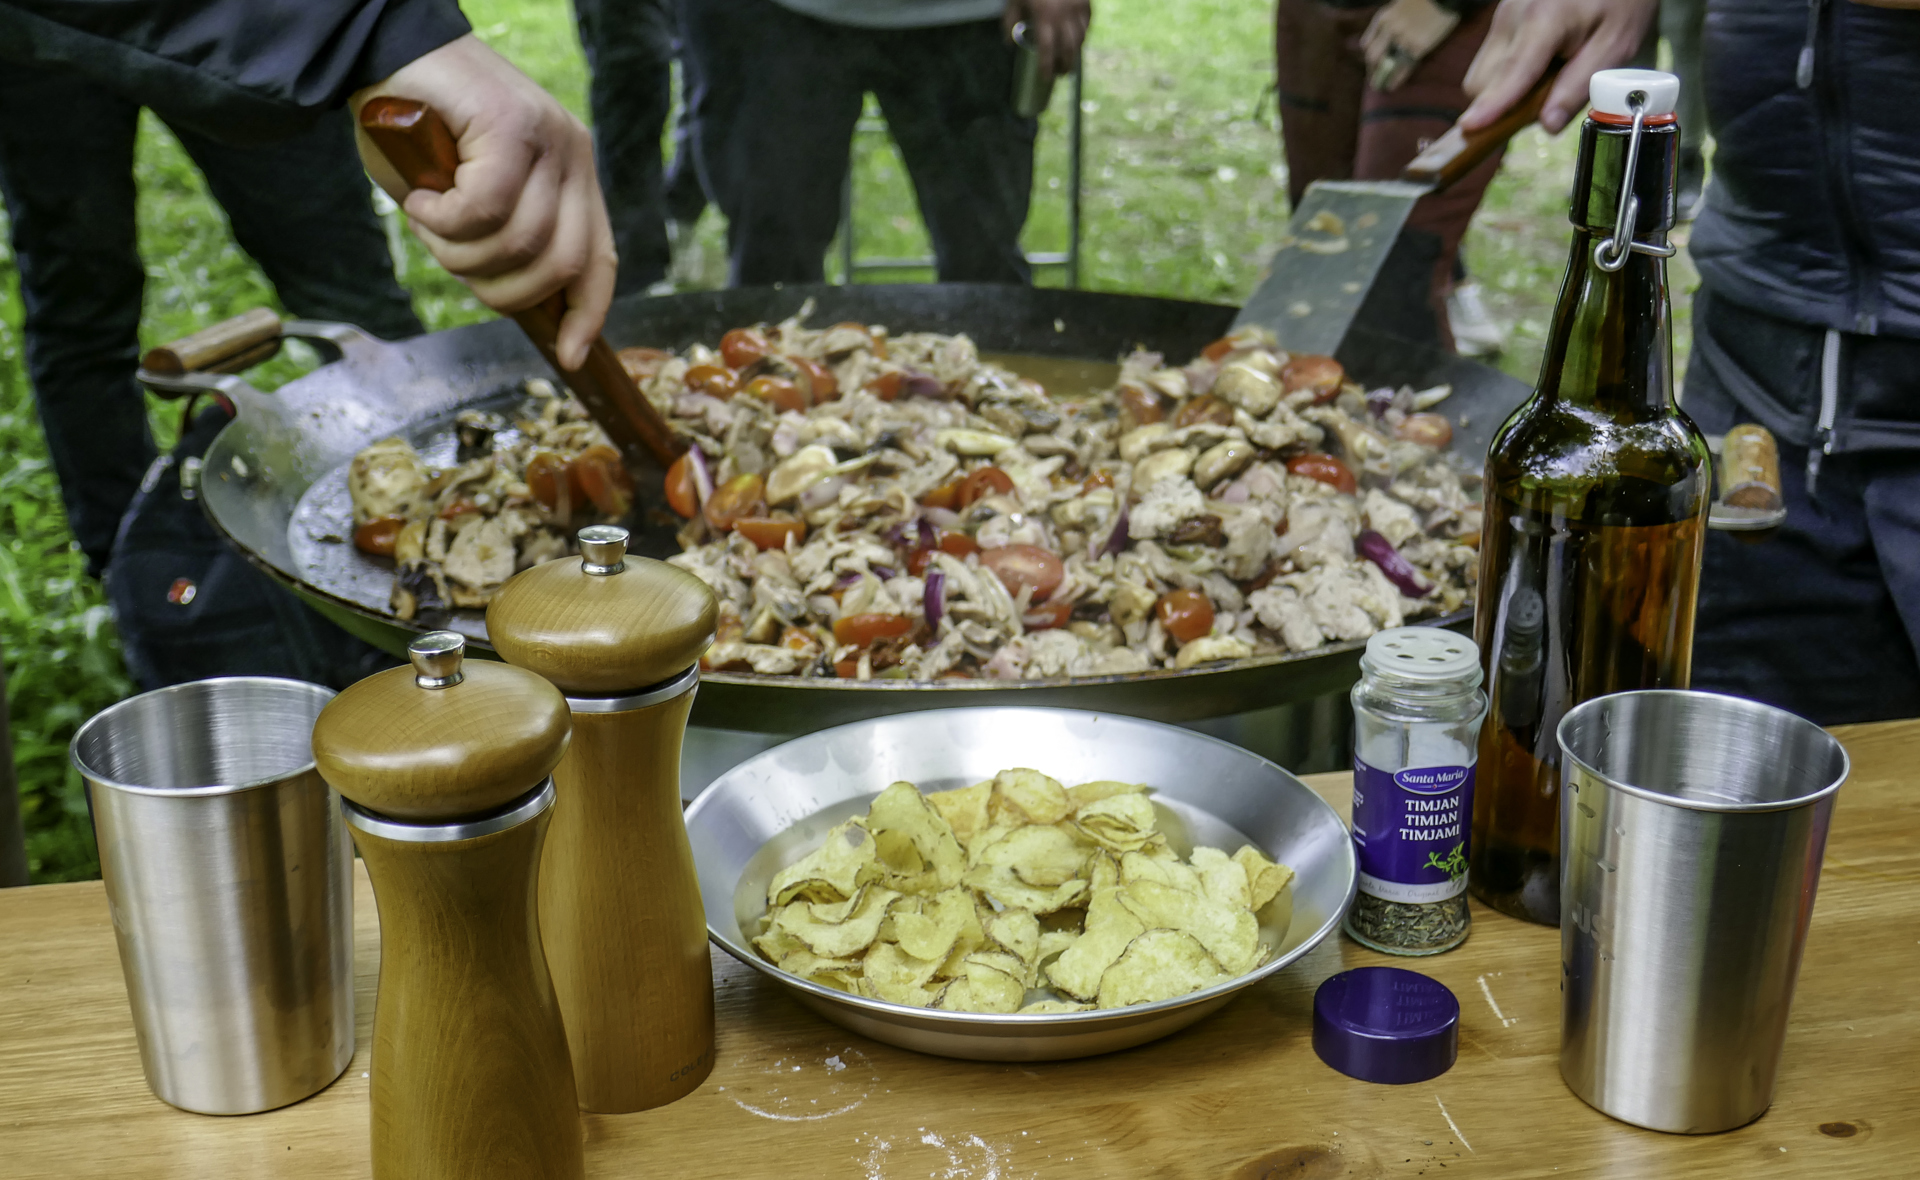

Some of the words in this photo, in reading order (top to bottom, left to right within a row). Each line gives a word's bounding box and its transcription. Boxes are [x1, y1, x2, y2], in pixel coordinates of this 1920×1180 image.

[1402, 772, 1434, 784] Santa
[1436, 769, 1464, 783] Maria
[1405, 796, 1459, 812] TIMJAN
[1405, 810, 1458, 827] TIMIAN
[1399, 824, 1460, 841] TIMJAMI
